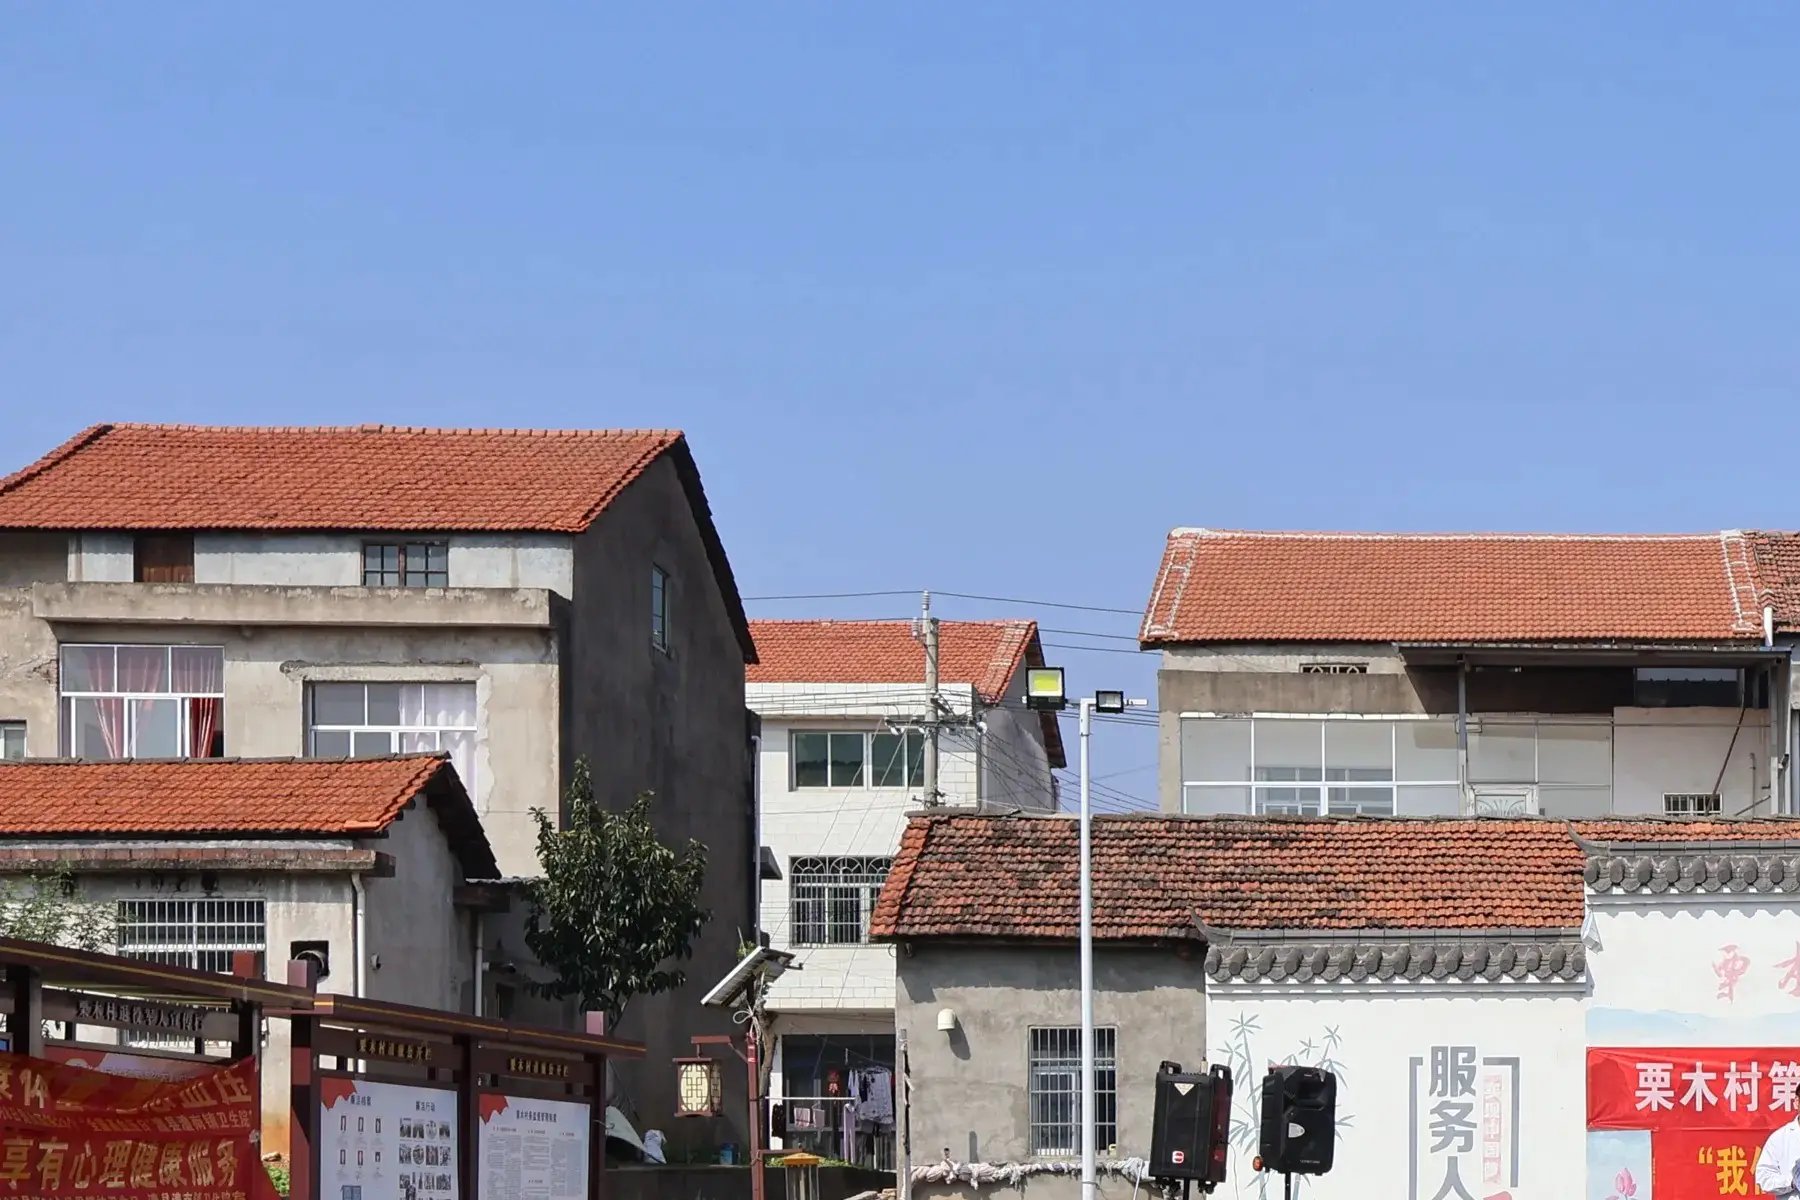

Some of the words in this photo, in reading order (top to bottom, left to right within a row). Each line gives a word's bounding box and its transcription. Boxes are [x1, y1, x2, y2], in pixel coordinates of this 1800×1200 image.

[0, 1135, 239, 1192] 享有心理健康服务
